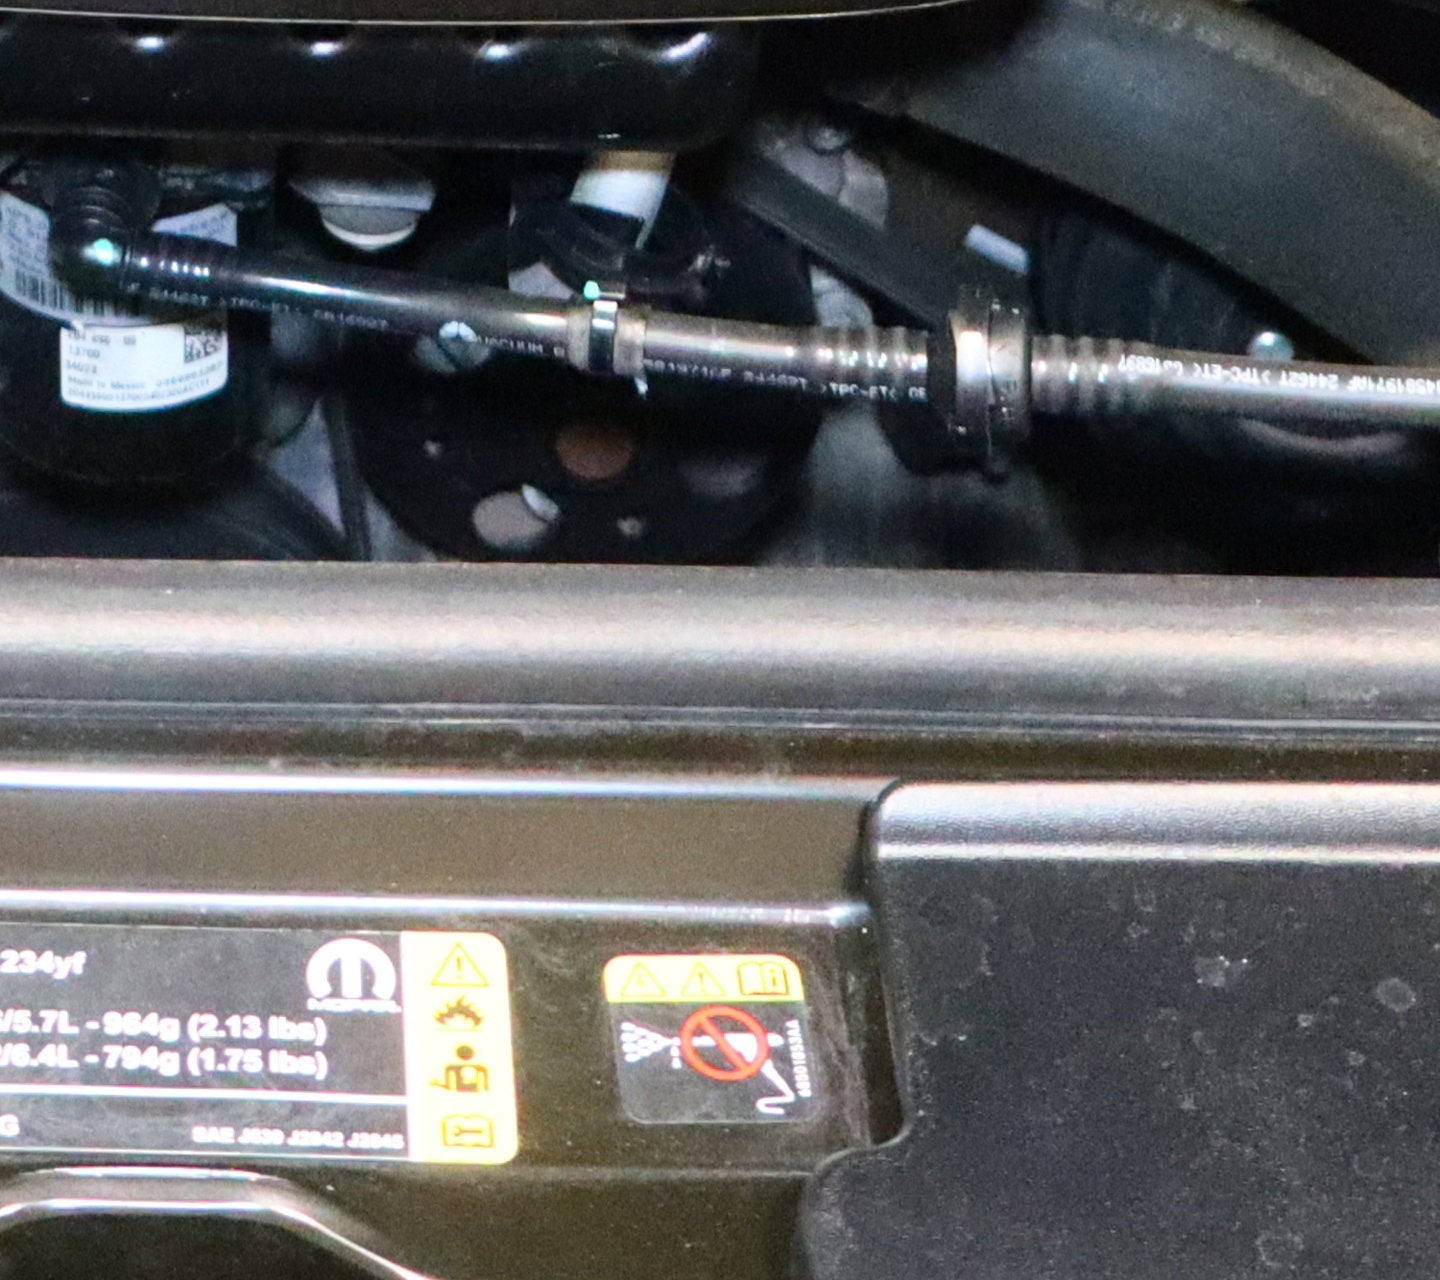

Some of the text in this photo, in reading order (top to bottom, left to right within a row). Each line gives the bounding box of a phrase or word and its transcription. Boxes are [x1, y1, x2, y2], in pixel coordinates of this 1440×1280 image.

[187, 1012, 263, 1043] (2.13
[268, 1015, 328, 1046] lbs)
[187, 1046, 264, 1077] (1.75
[268, 1048, 328, 1081] lbs)
